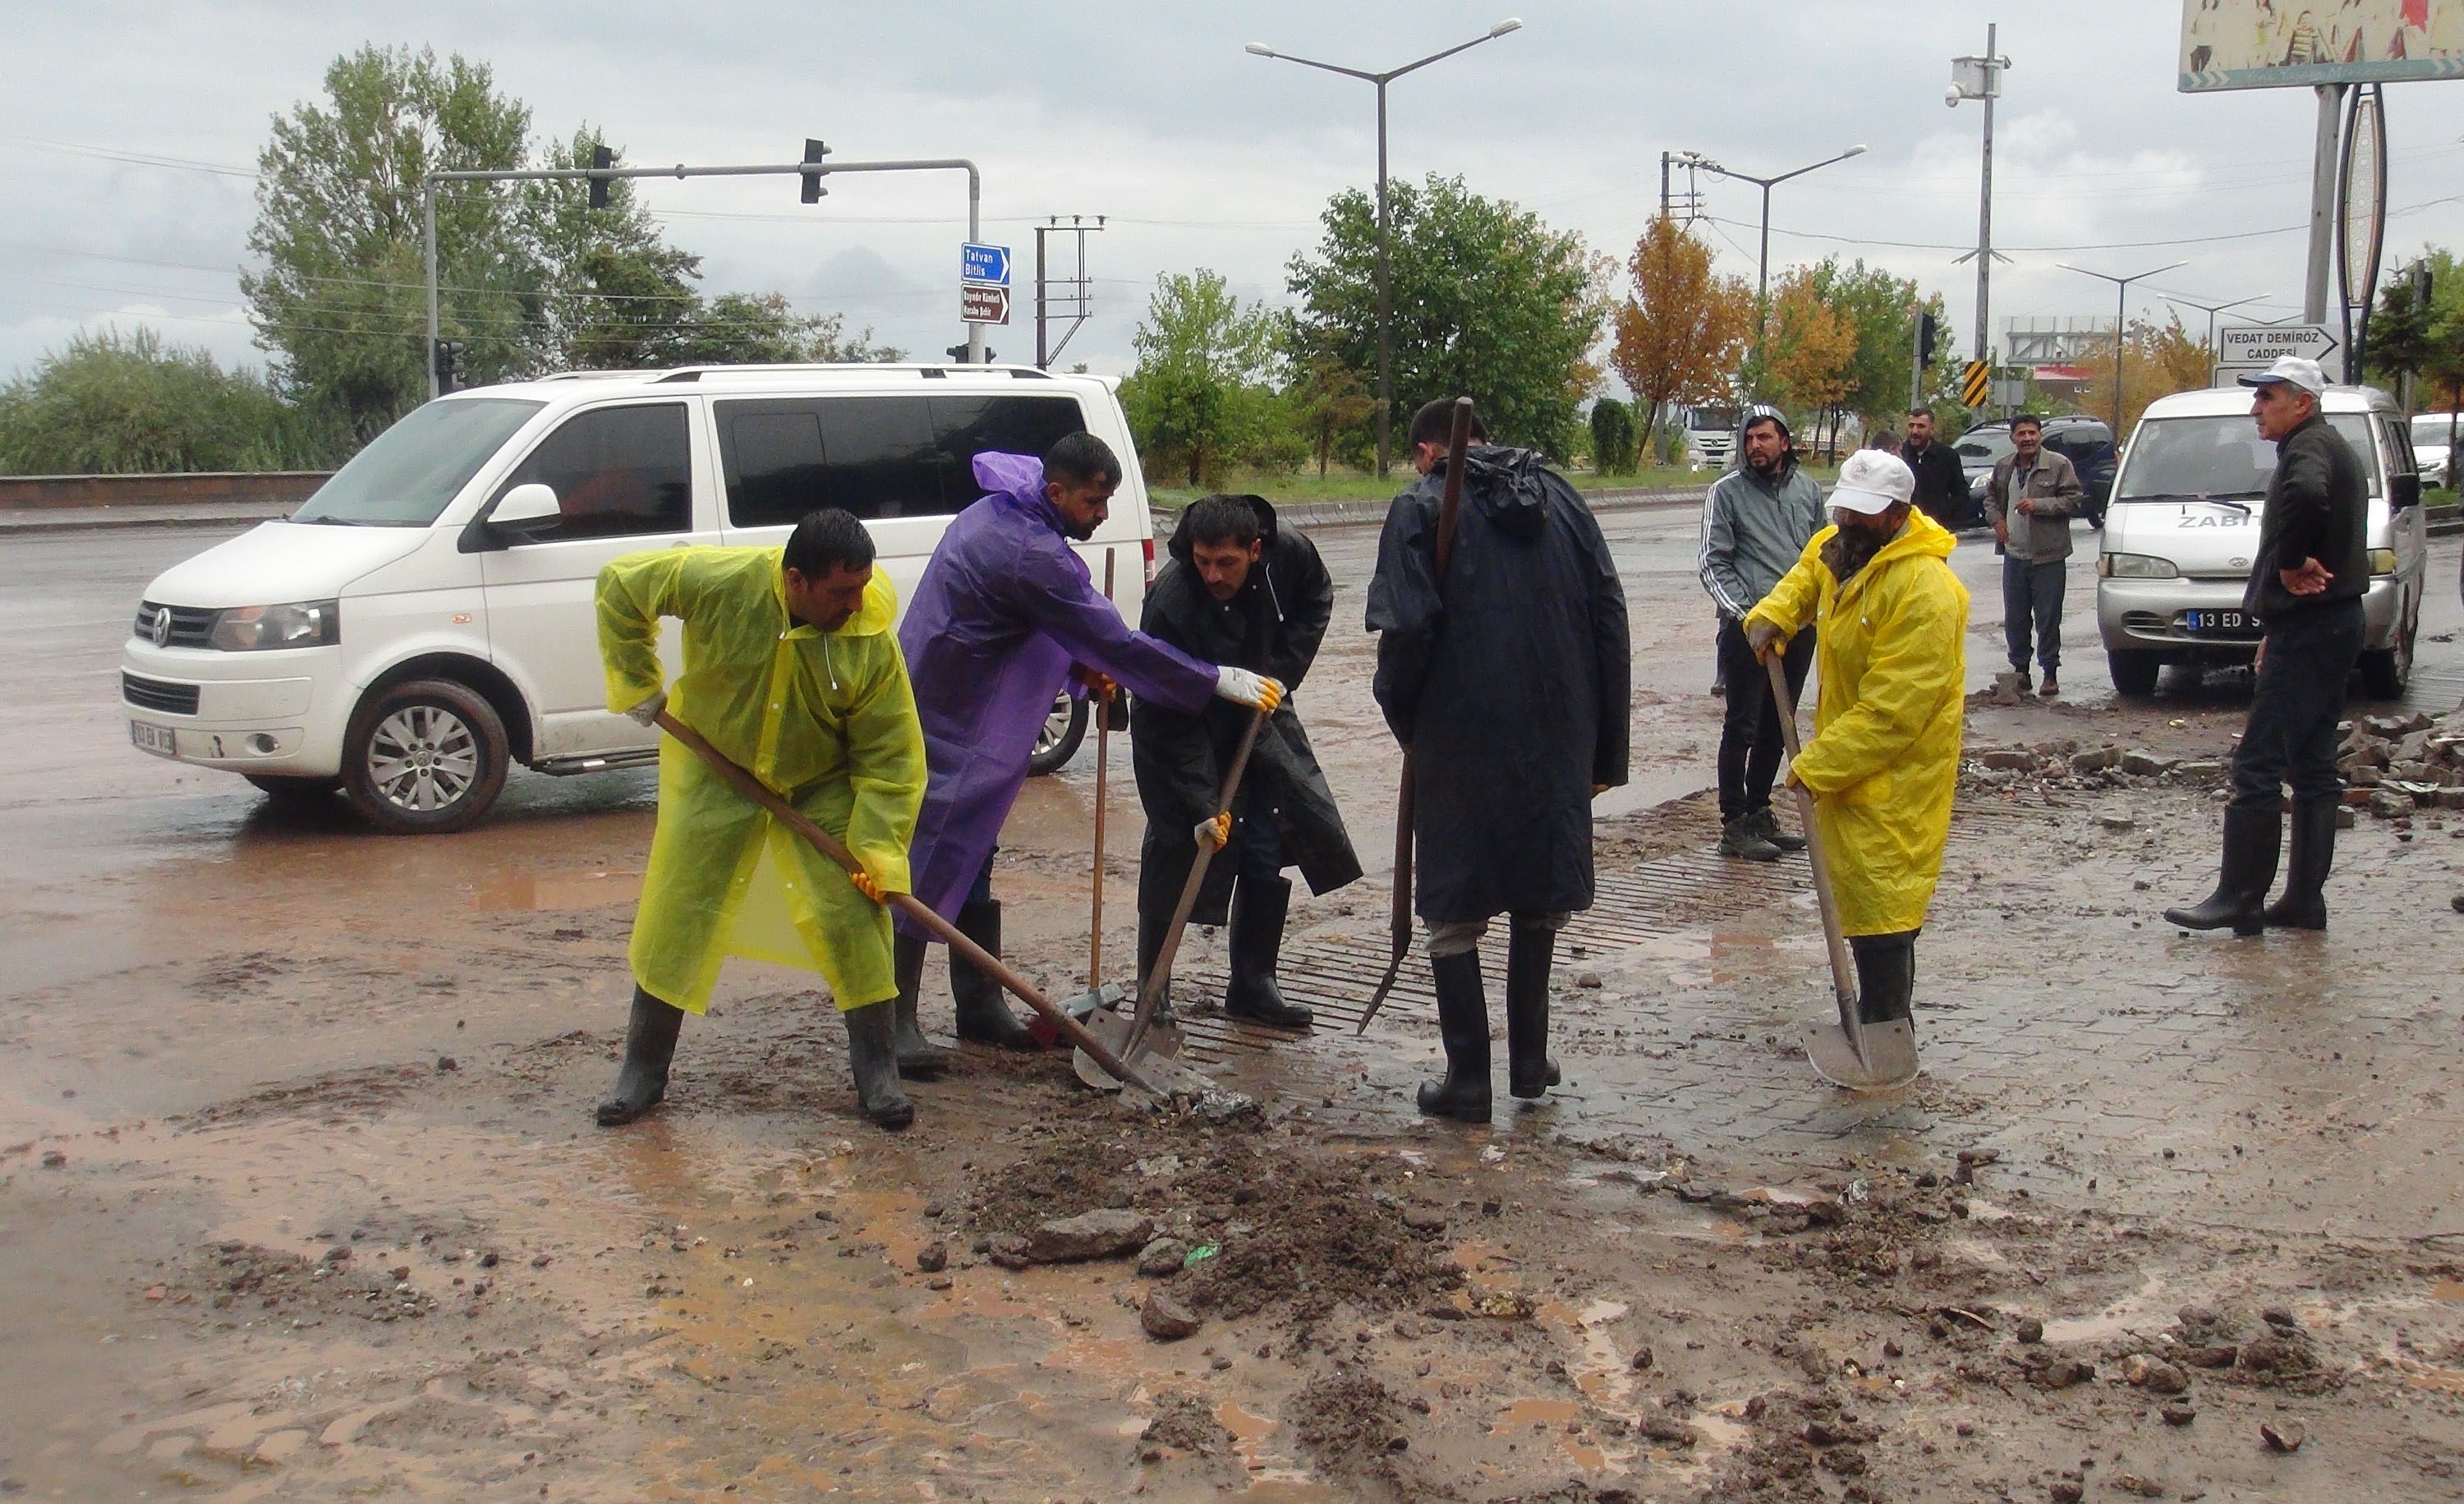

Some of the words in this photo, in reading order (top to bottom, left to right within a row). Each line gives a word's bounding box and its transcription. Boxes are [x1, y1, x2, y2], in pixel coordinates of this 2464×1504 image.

[966, 250, 993, 264] Tatvan
[965, 262, 986, 276] Bitlis
[2227, 333, 2264, 343] VEDAT
[2198, 613, 2215, 627] 13
[2222, 613, 2241, 627] ED
